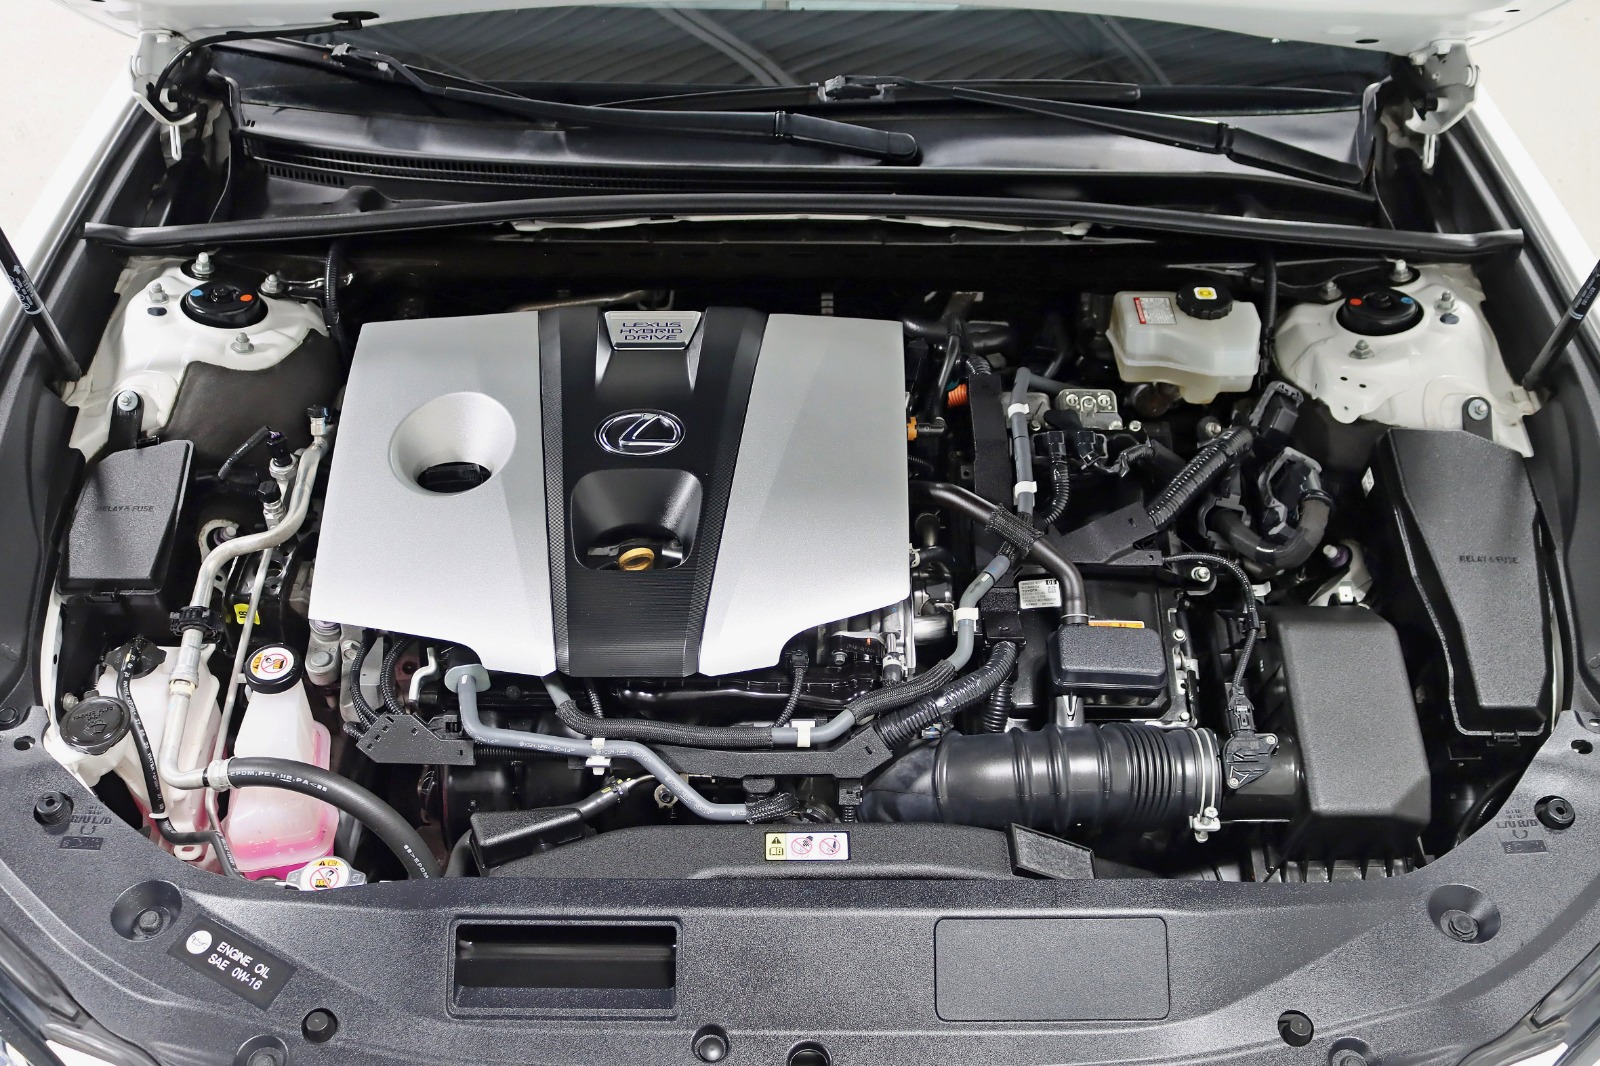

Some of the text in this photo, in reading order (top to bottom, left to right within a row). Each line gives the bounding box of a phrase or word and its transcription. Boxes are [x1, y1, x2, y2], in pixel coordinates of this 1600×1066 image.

[1495, 556, 1519, 564] FUSE
[207, 953, 263, 990] SAE 0W-16
[216, 941, 271, 979] ENGINE OIL
